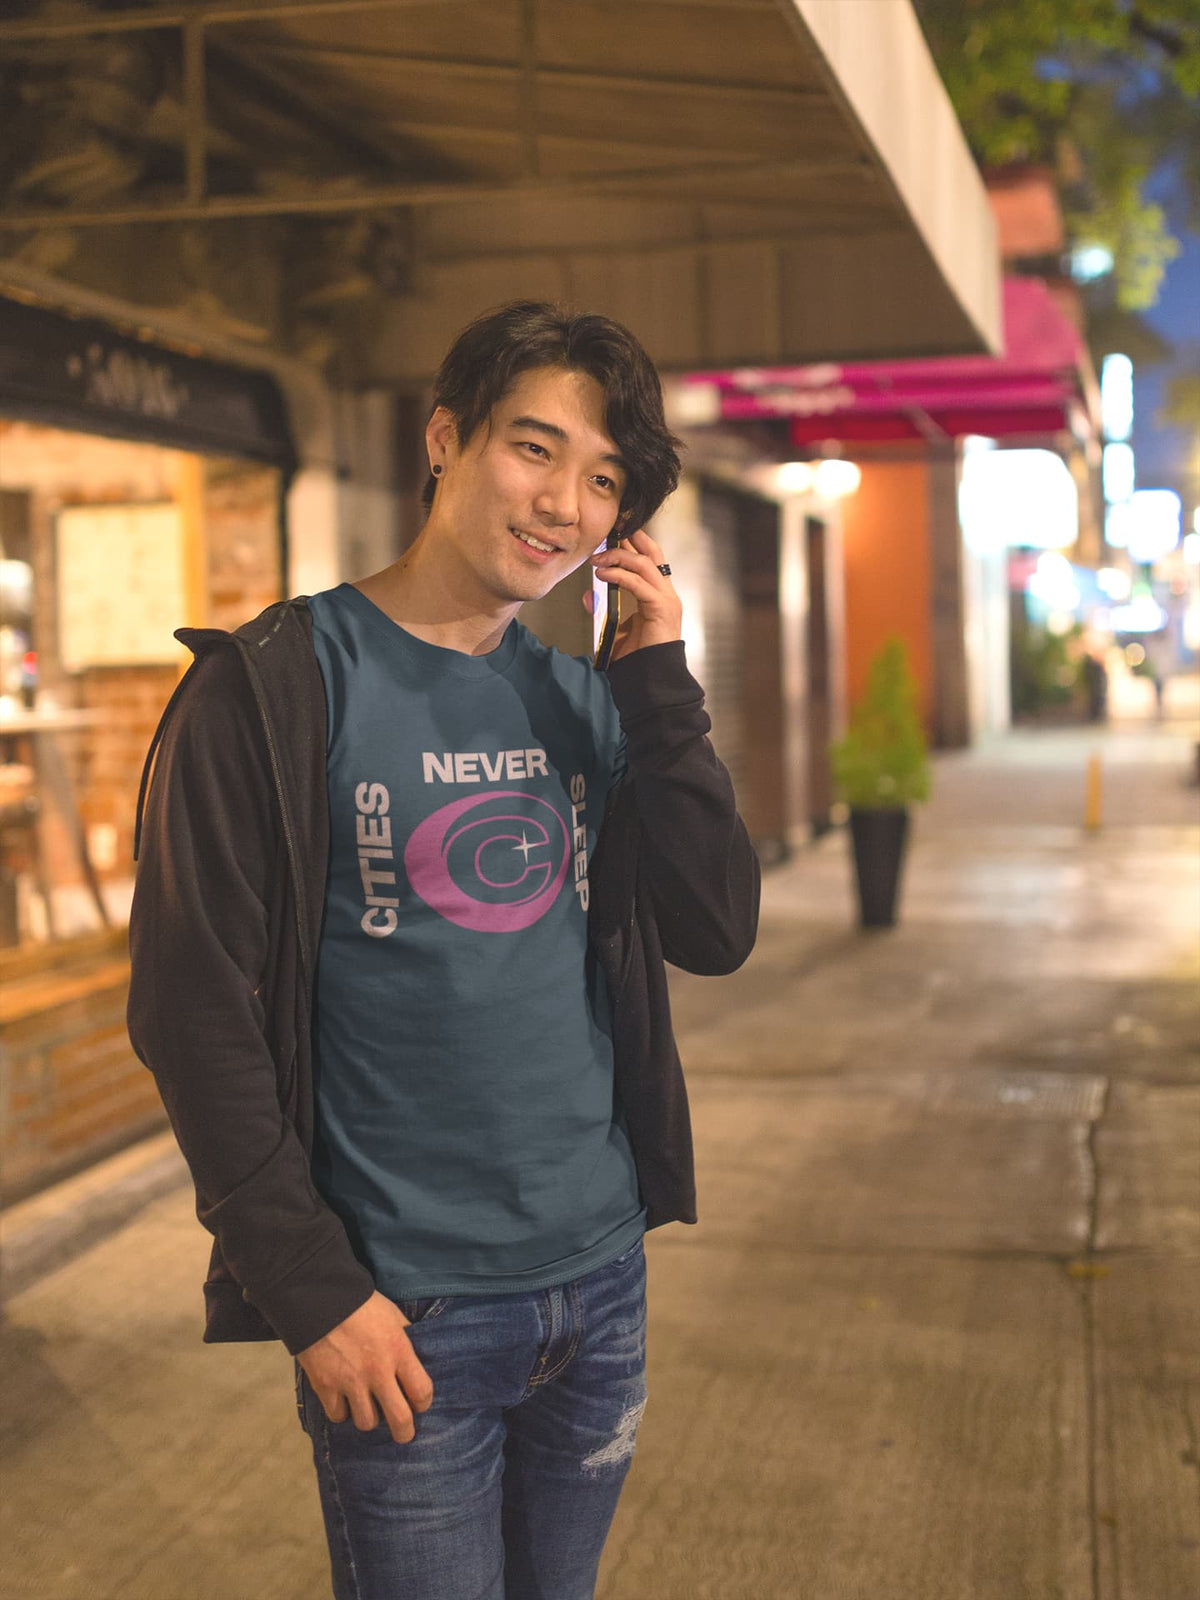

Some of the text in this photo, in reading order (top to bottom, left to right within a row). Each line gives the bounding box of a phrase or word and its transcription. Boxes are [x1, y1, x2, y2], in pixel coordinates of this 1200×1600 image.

[422, 749, 549, 784] NEVER
[354, 781, 400, 938] CITIES
[570, 773, 590, 912] SLEEP
